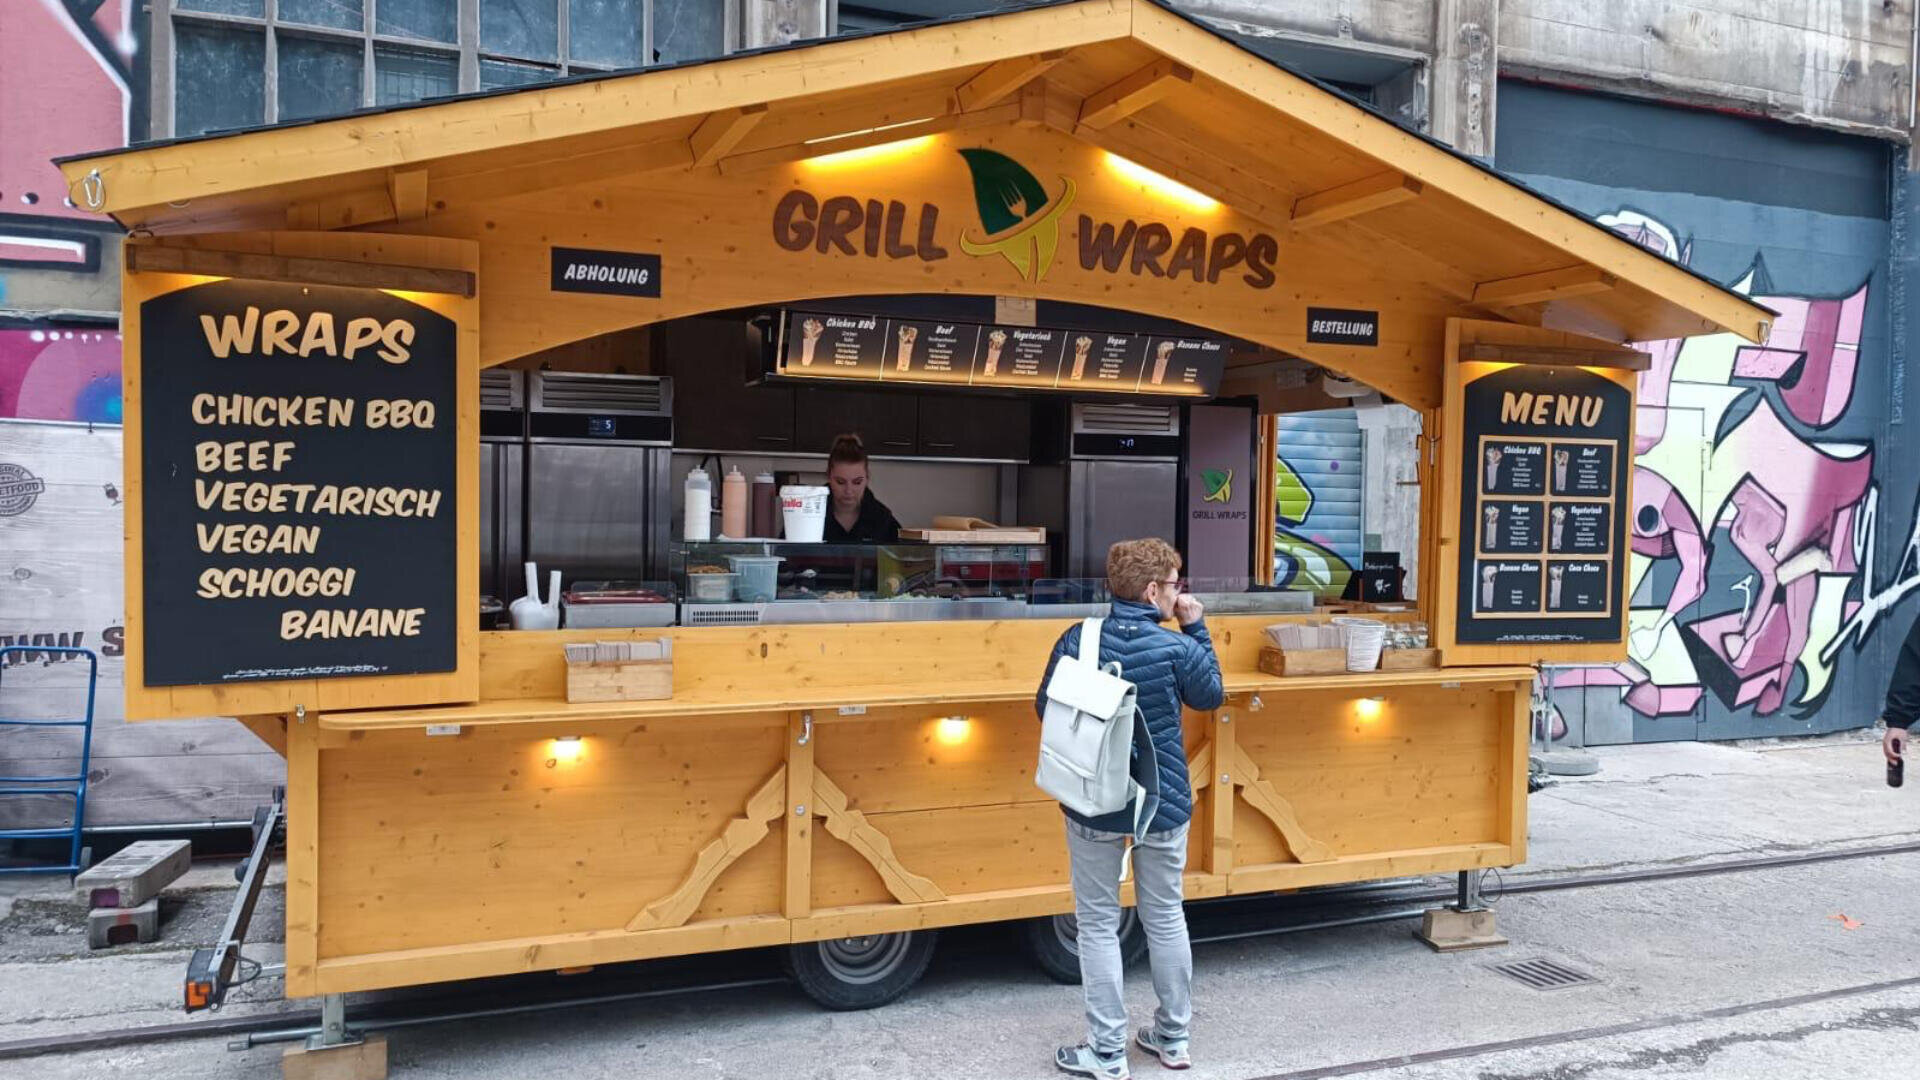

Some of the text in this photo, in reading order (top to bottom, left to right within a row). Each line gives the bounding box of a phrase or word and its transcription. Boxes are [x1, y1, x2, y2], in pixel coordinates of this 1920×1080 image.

[773, 189, 1279, 290] GRILL WRAPS
[564, 263, 649, 285] ABHOLUNG
[200, 306, 416, 364] WRAPS
[826, 317, 857, 328] Chicken
[1312, 320, 1374, 336] BESTELLUNG
[192, 393, 436, 429] CHICKEN BBQ
[1501, 391, 1604, 428] MENU
[195, 440, 296, 473] BEEF
[195, 478, 442, 518] VEGETARISCH
[1192, 511, 1248, 520] GRILL WRAPS
[196, 523, 321, 554] VEGAN
[196, 567, 357, 598] SCHOGGI
[280, 607, 426, 641] BANANE
